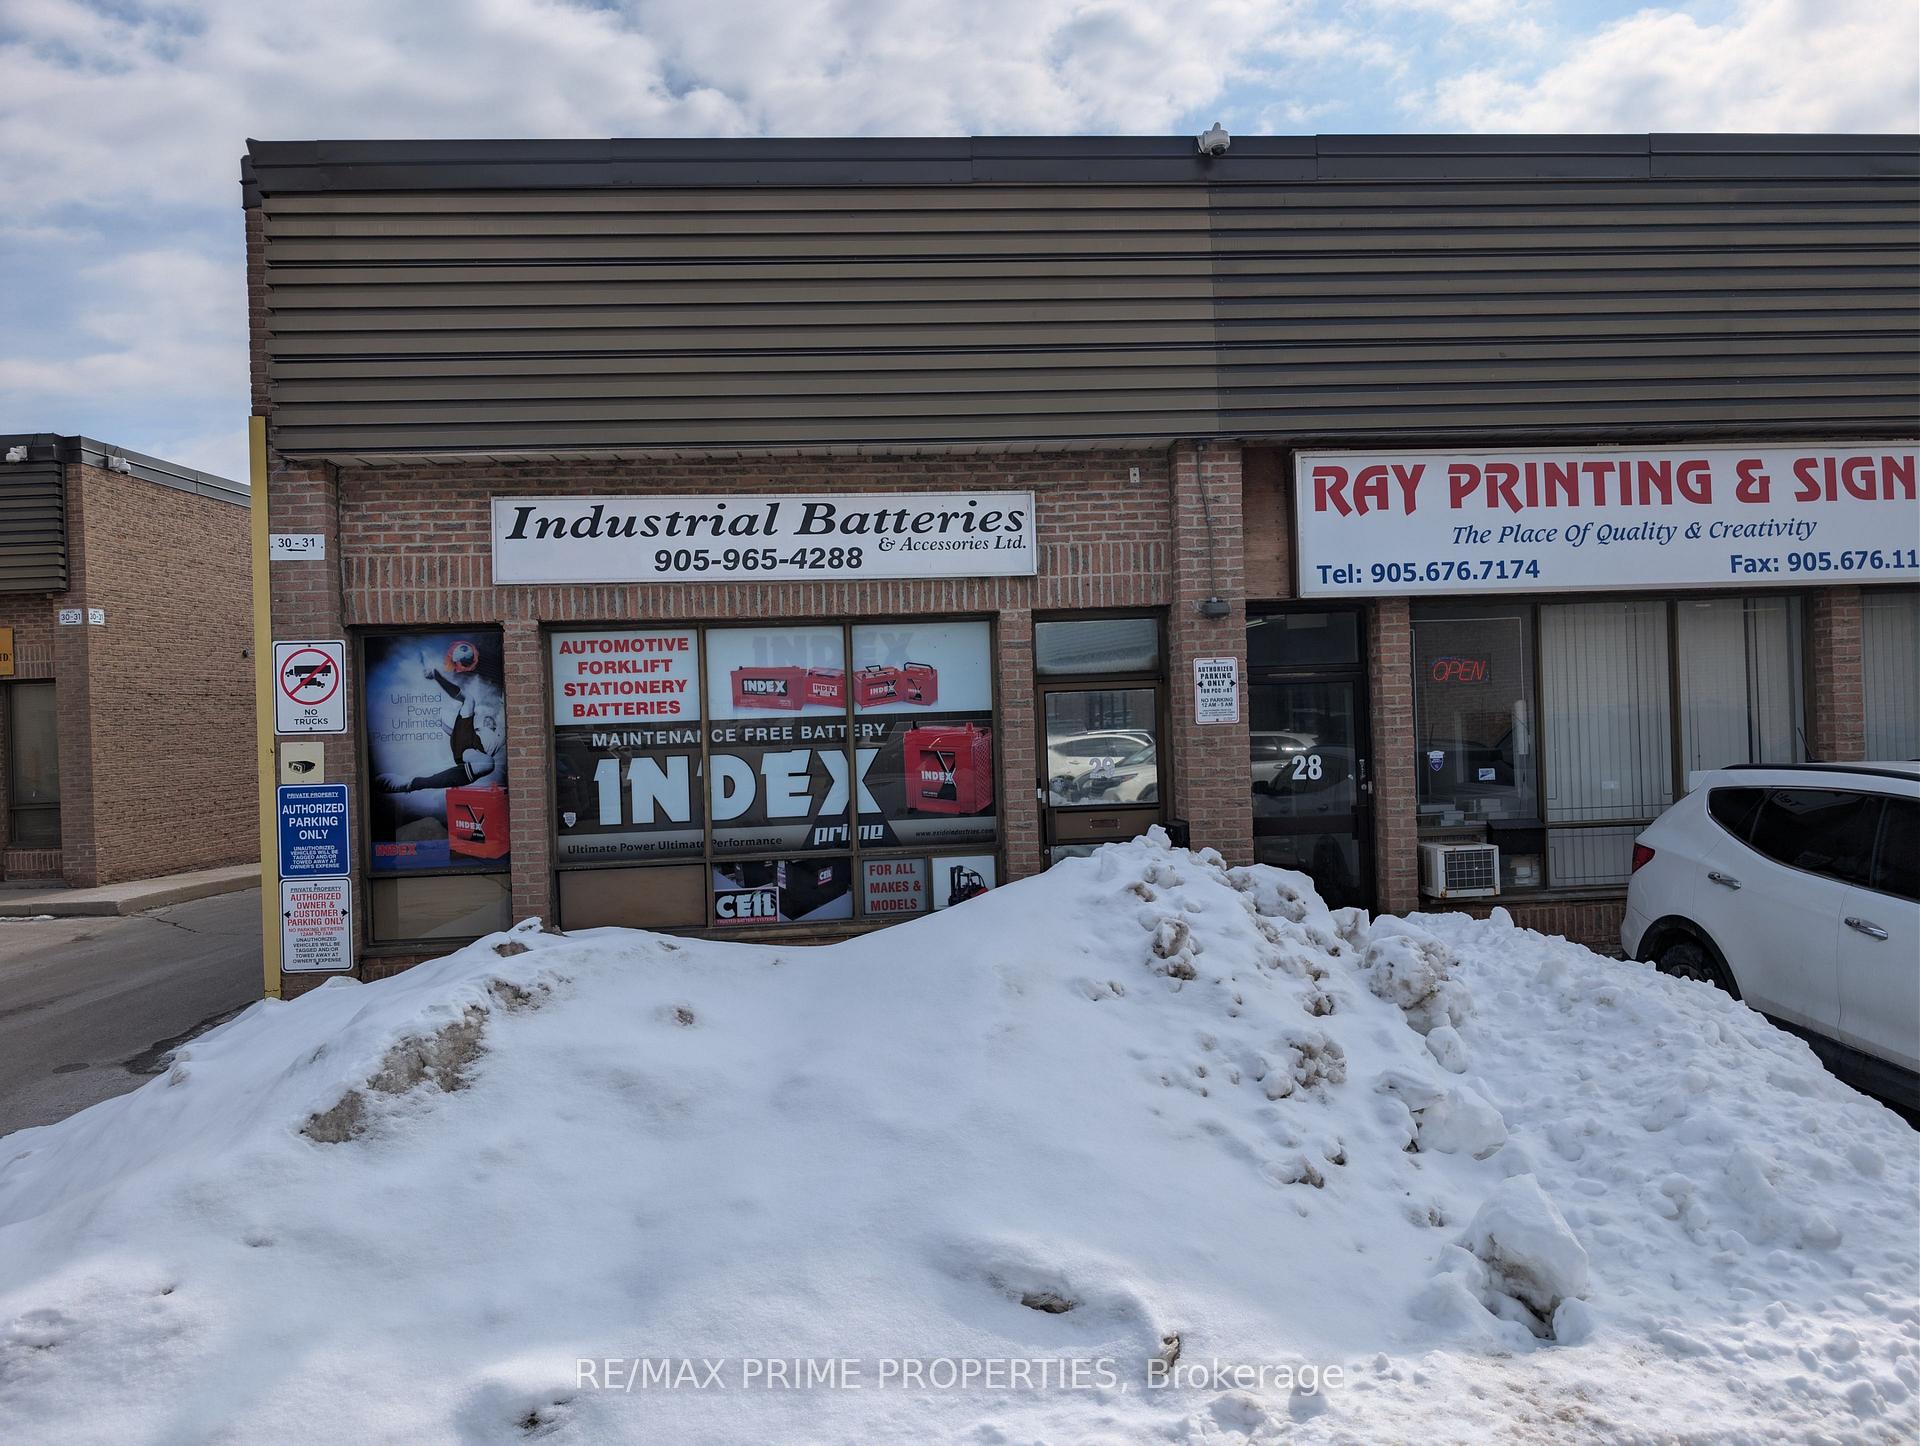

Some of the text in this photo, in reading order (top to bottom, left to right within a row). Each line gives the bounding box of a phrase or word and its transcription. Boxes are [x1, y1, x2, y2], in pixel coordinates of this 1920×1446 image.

[1312, 455, 1916, 517] RAY PRINTING & SIGN
[505, 500, 1024, 539] Industrial Batteries
[1453, 518, 1817, 547] The Place Of Quality & Creativity
[878, 535, 1027, 551] & Accessories Ltd.
[654, 546, 863, 571] 905-965-4288
[1730, 550, 1919, 574] Fax: 905.676.11
[1316, 559, 1540, 584] Tel: 905.676.7174
[559, 637, 689, 655] AUTOMOTIVE
[752, 632, 914, 667] INDEX
[577, 658, 673, 675] FORKLIFT
[1433, 659, 1487, 681] OPEN
[564, 679, 688, 697] STATIONERY
[743, 679, 788, 694] INDEX
[814, 684, 837, 692] INDEX
[390, 693, 442, 704] Unlimited
[407, 705, 442, 716] Power
[572, 700, 681, 718] BATTERIES
[294, 717, 329, 725] TRUCKS
[392, 718, 442, 729] Unlimited
[373, 732, 443, 742] Performance
[744, 727, 793, 742] FREE
[801, 723, 886, 740] BATTERY
[1292, 754, 1322, 781] 28
[921, 770, 954, 781] INDEX
[593, 748, 882, 826] INDEX
[282, 803, 345, 814] AUTHORIZED
[289, 816, 338, 827] PARKING
[456, 820, 482, 831] INDEX
[299, 829, 328, 840] ONLY
[568, 837, 783, 854] Ultimate Power Ultimate Performance
[869, 863, 915, 876] FOR ALL
[870, 881, 921, 893] MAKES &
[290, 892, 342, 901] AUTHORIZED
[716, 890, 775, 918] CEIL
[297, 901, 335, 909] OWNER &
[870, 899, 917, 912] MODELS
[293, 909, 338, 918] CUSTOMER
[287, 917, 344, 926] PARKING ONLY
